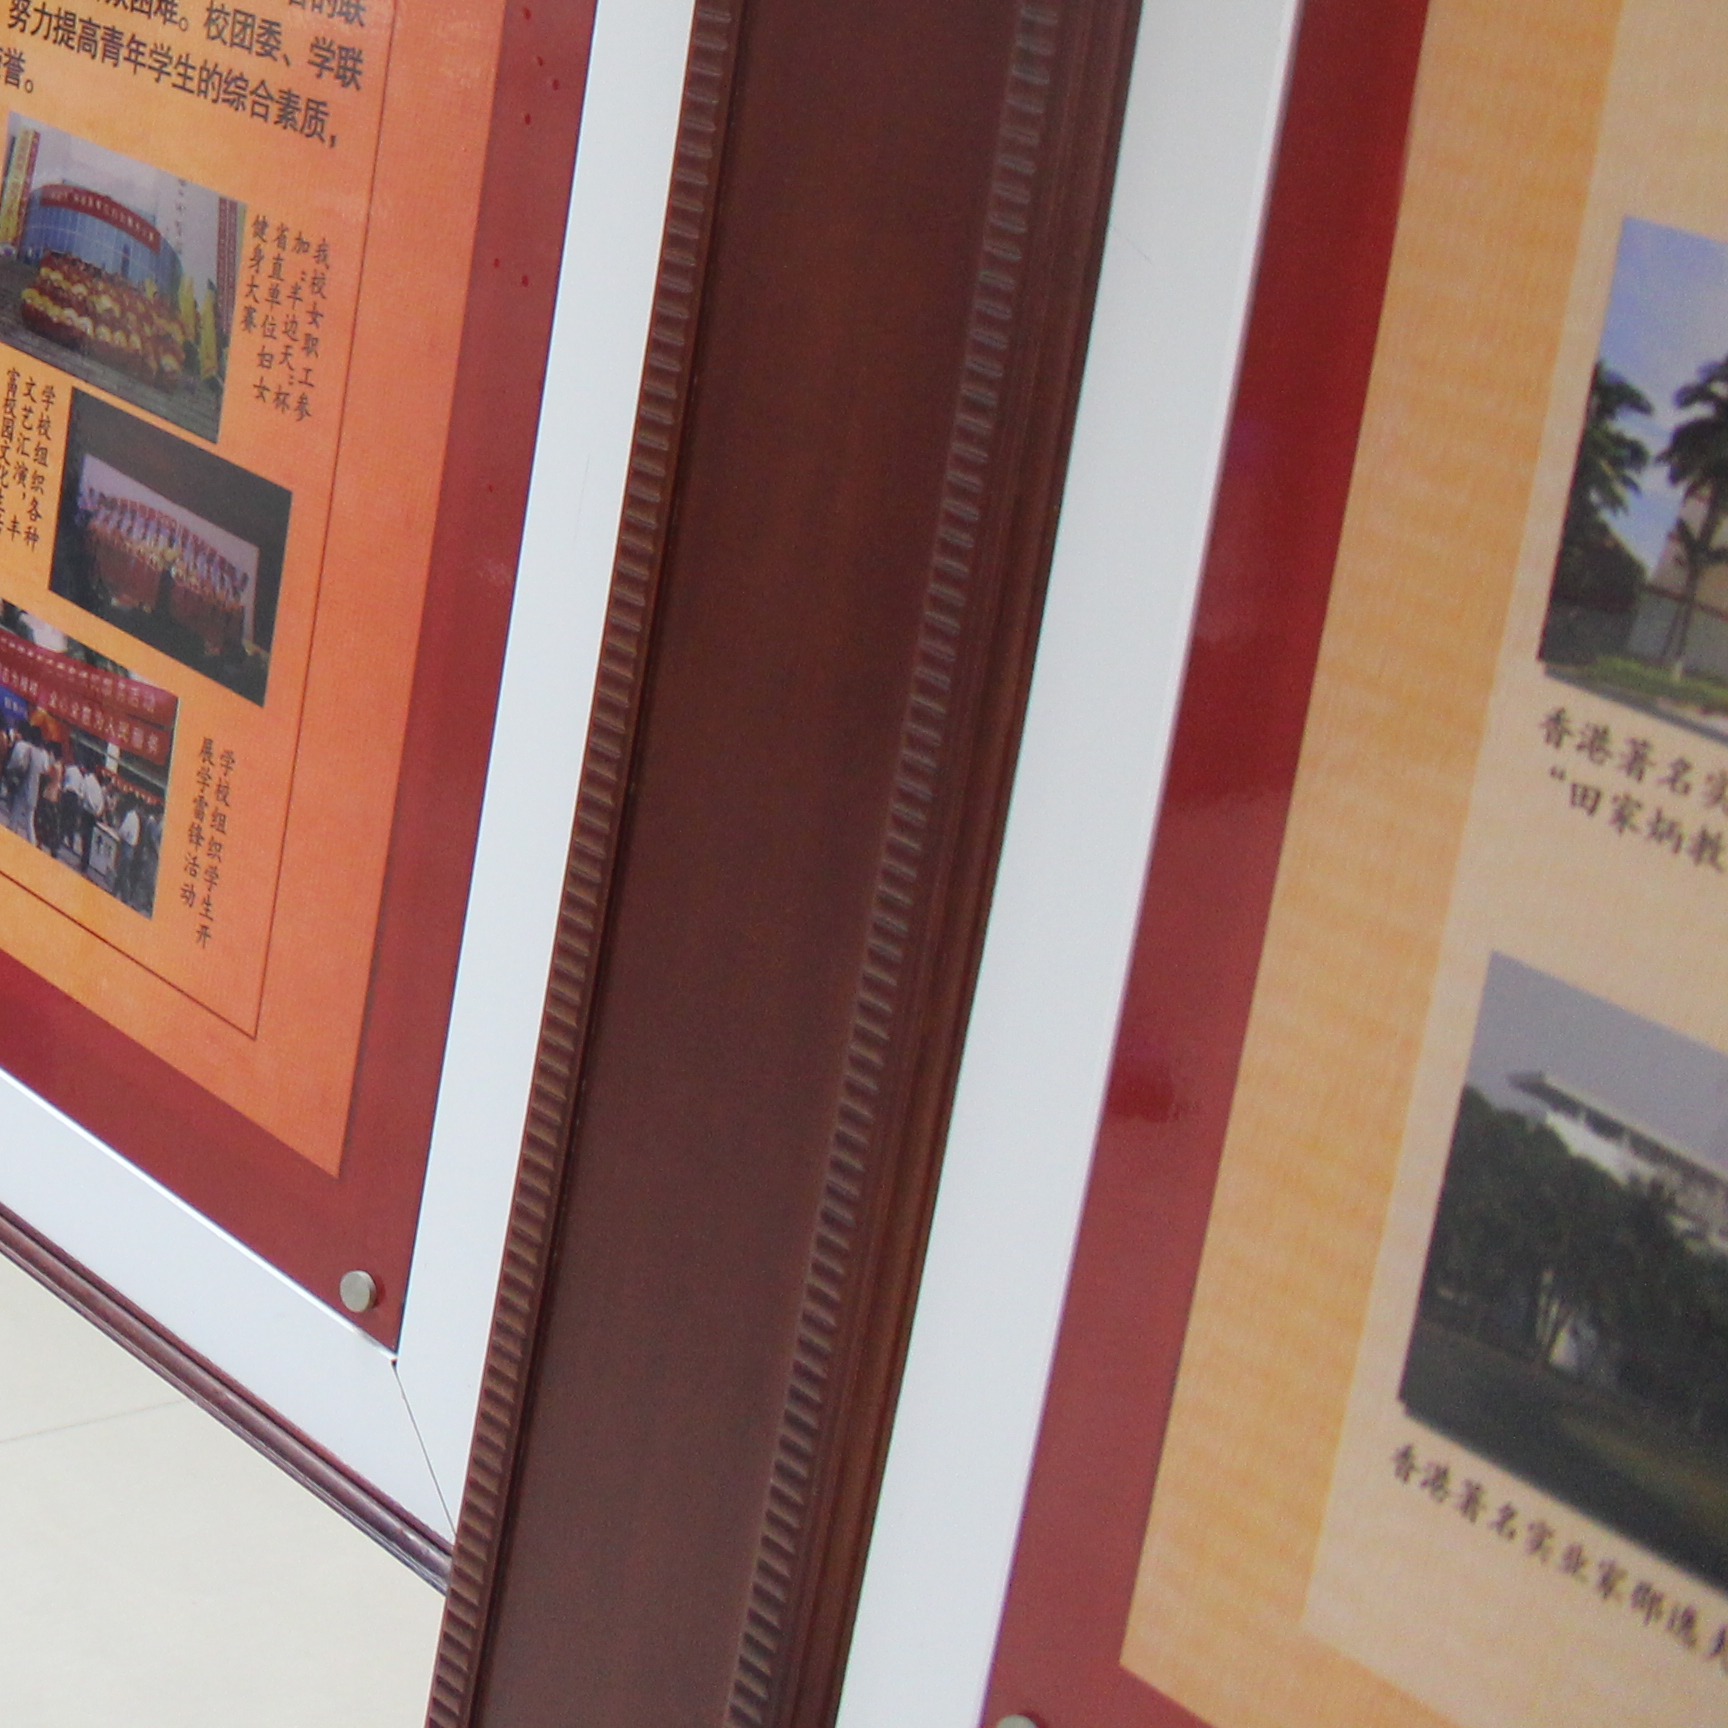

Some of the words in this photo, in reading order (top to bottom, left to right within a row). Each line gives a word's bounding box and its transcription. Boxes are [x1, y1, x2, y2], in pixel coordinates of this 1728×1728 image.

[253, 222, 289, 403] 省直单位妇女
